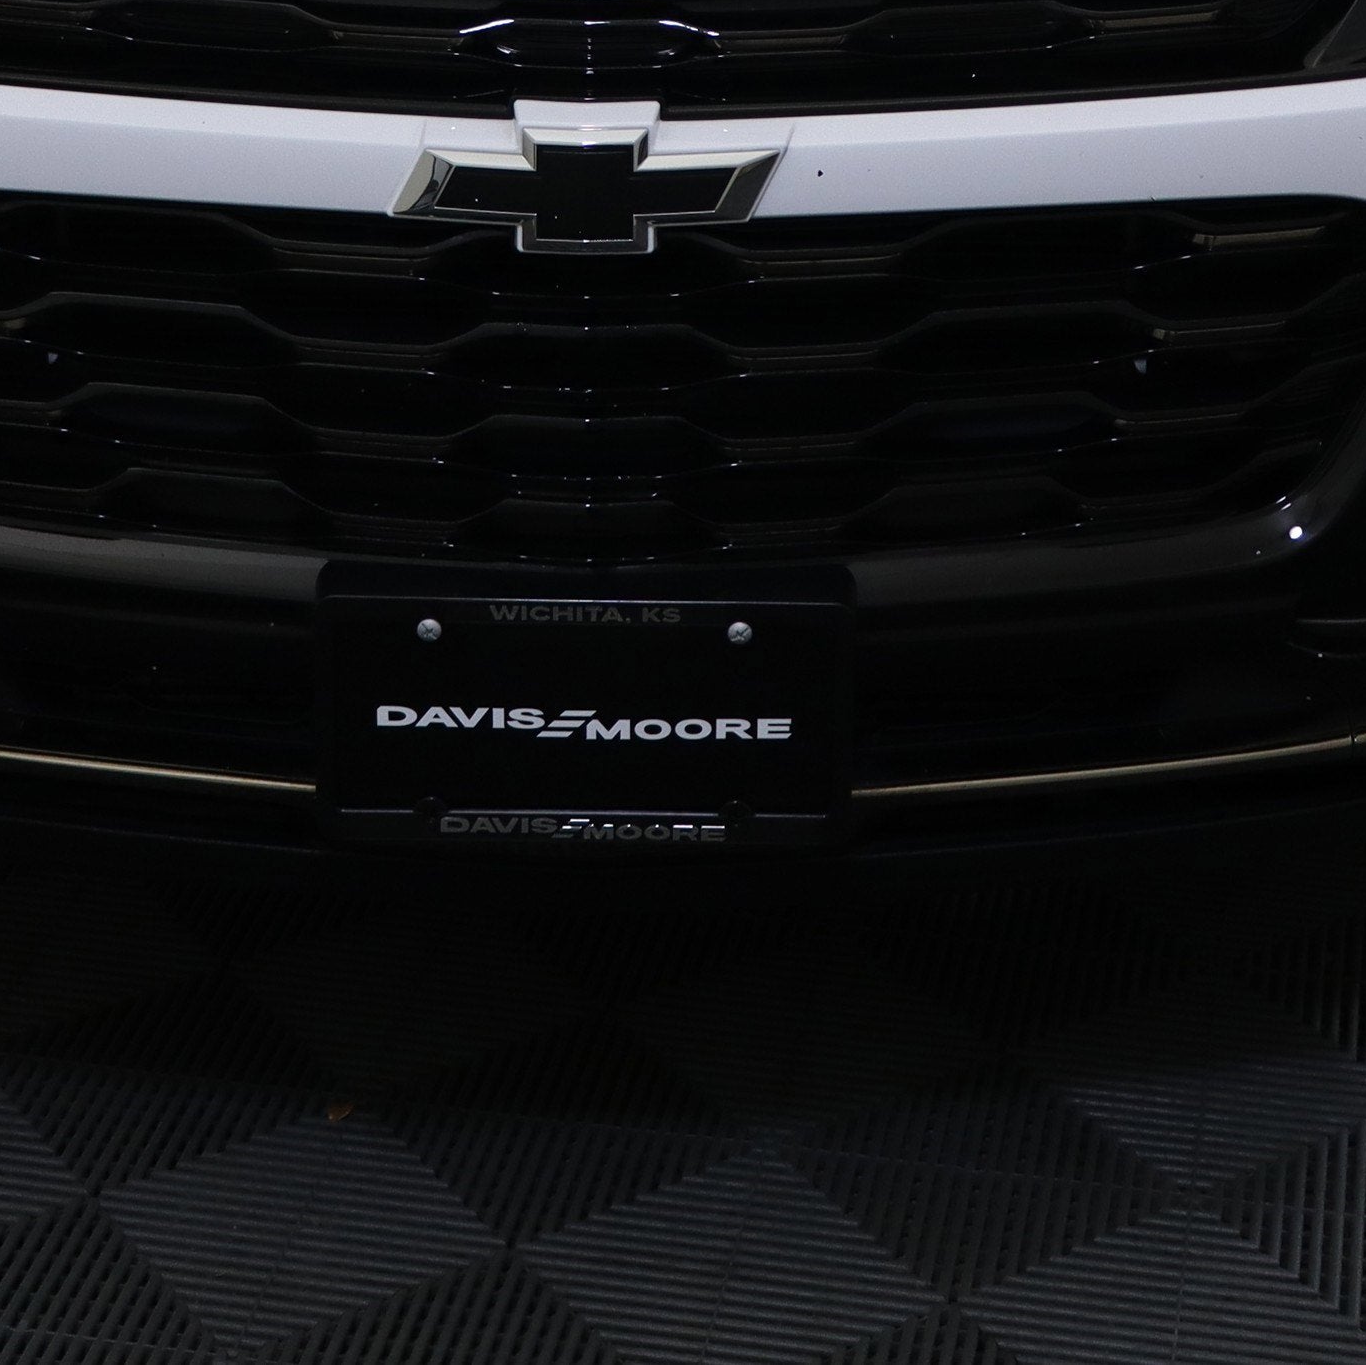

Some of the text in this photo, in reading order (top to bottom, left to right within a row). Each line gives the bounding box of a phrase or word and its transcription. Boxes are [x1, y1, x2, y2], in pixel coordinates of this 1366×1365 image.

[489, 604, 682, 624] WICHITA, KS
[376, 705, 793, 741] DAVIS MOORE
[439, 816, 728, 843] DAVIS MOORE
